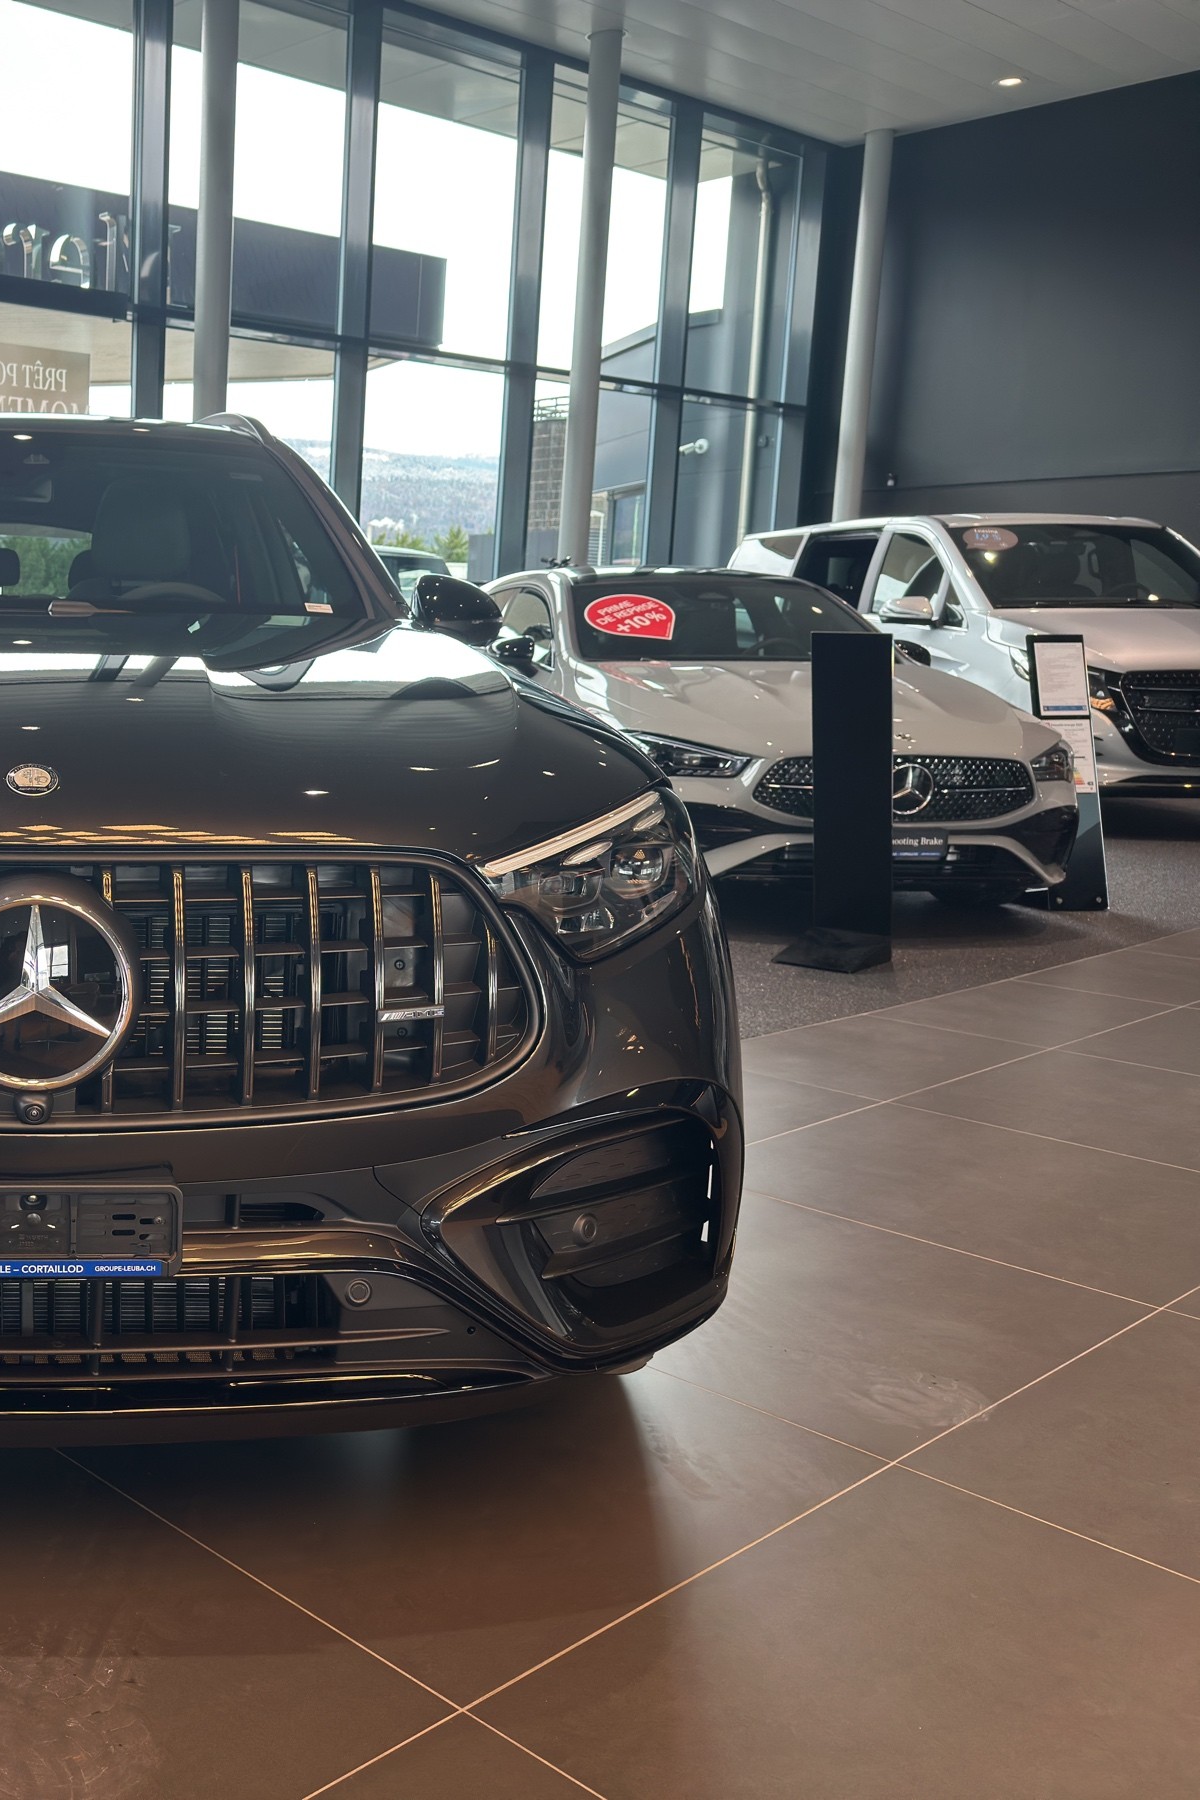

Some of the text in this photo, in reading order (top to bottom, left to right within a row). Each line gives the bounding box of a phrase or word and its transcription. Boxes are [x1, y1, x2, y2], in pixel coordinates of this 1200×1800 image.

[596, 601, 659, 625] DE REPRISE
[597, 600, 634, 615] PRIME
[892, 837, 943, 847] ooting Brake
[21, 1265, 84, 1274] CORTAILLOD
